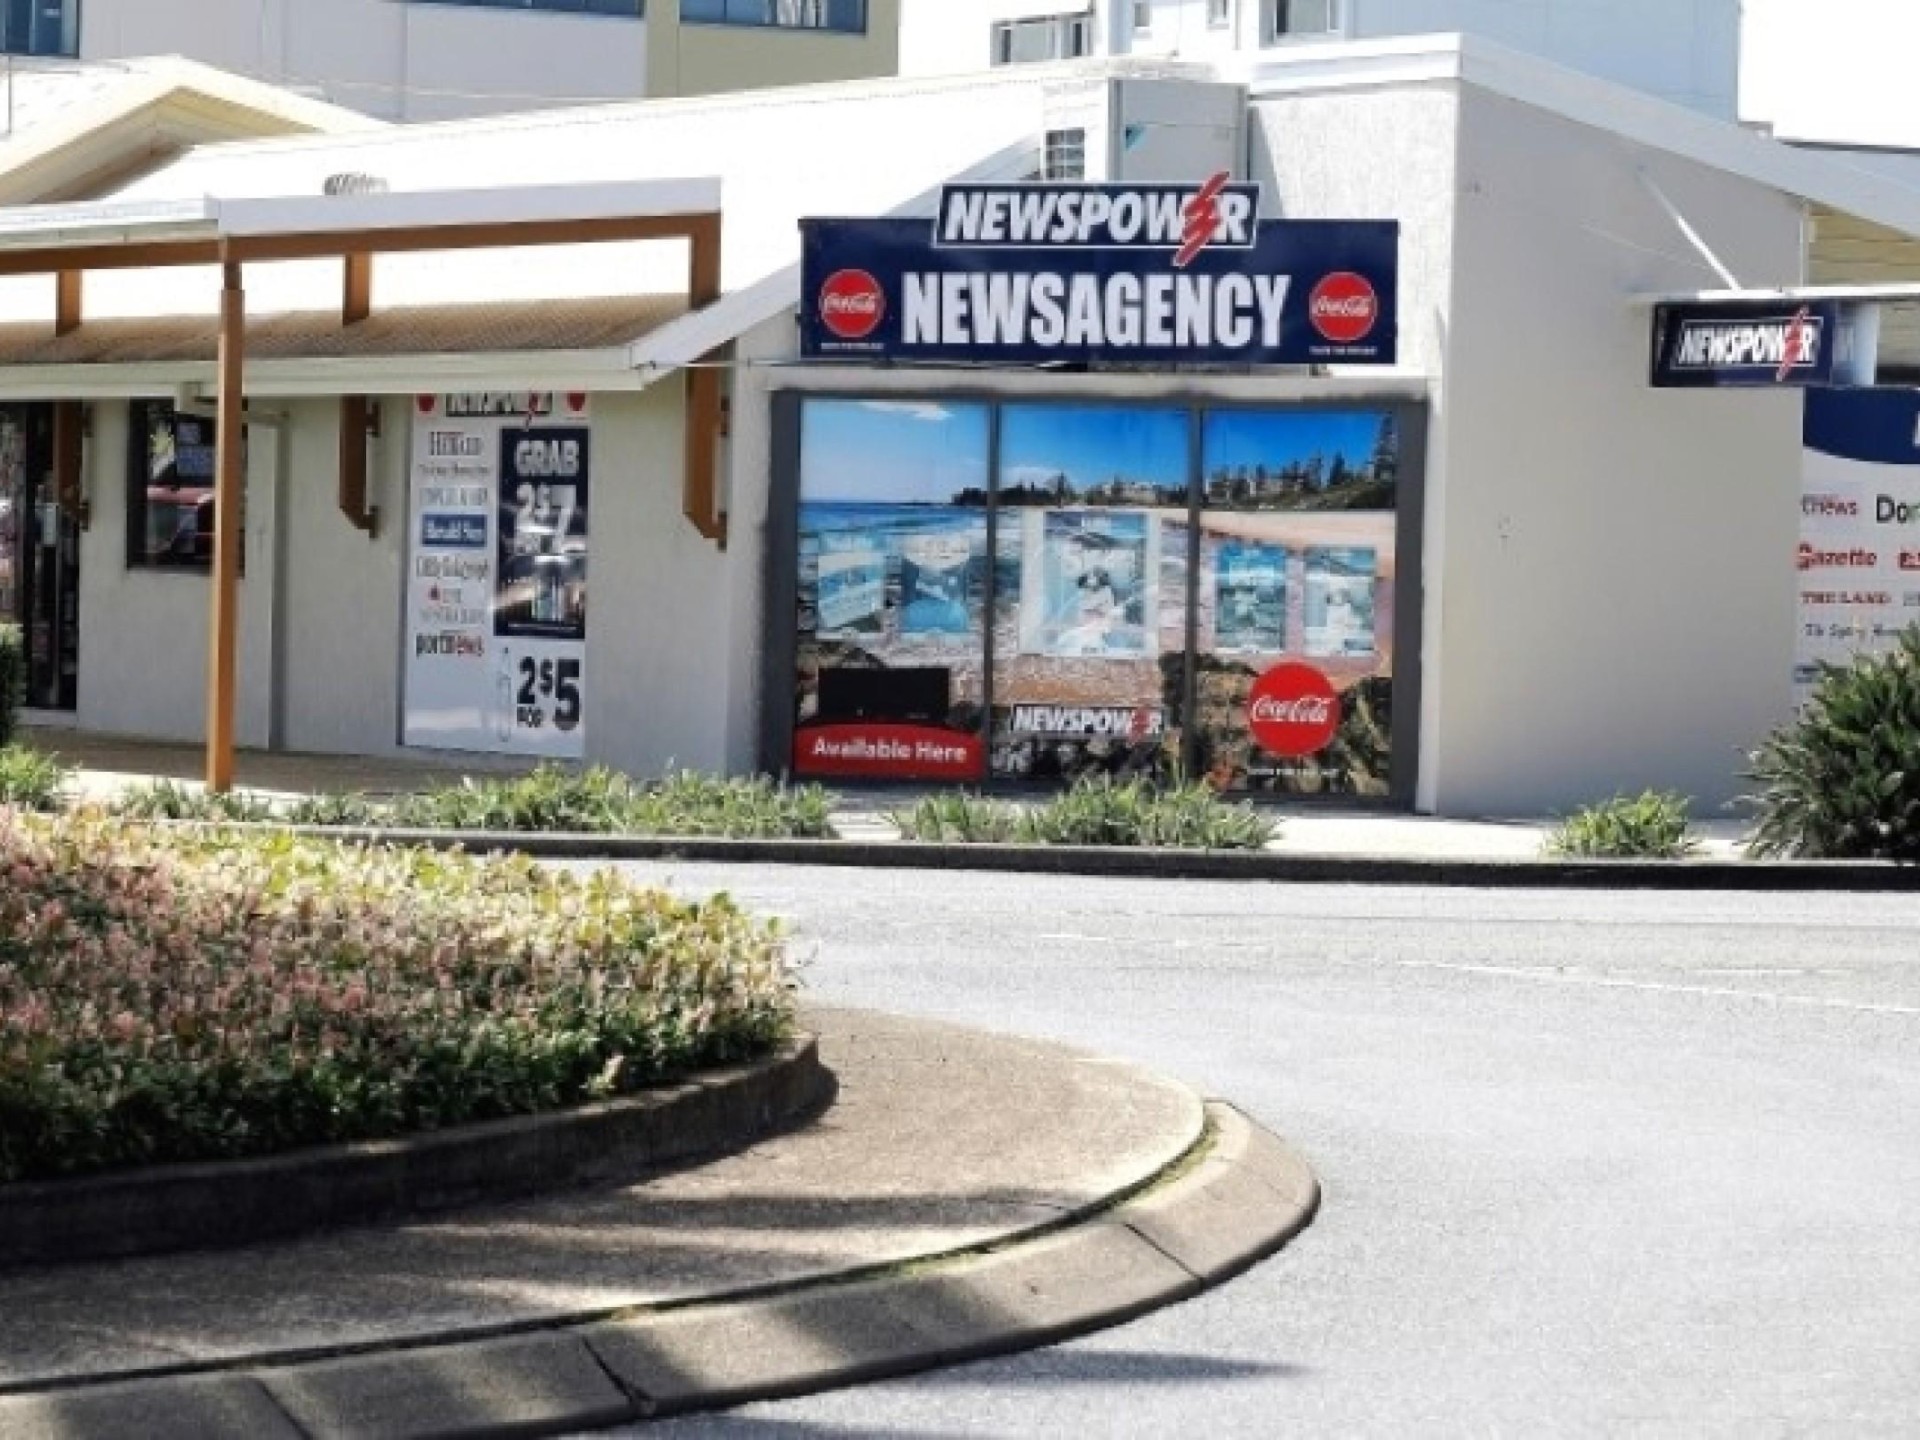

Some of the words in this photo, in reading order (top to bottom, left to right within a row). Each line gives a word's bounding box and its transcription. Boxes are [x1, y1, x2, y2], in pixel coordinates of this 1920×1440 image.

[943, 185, 1253, 247] NEWSPOWER
[903, 272, 1291, 347] NEWSAGENCY
[1677, 323, 1816, 364] NEWSPOWER
[516, 440, 579, 476] GRAB
[1014, 705, 1164, 735] NEWSPOWER
[812, 735, 912, 760] Available
[915, 741, 967, 763] Here
